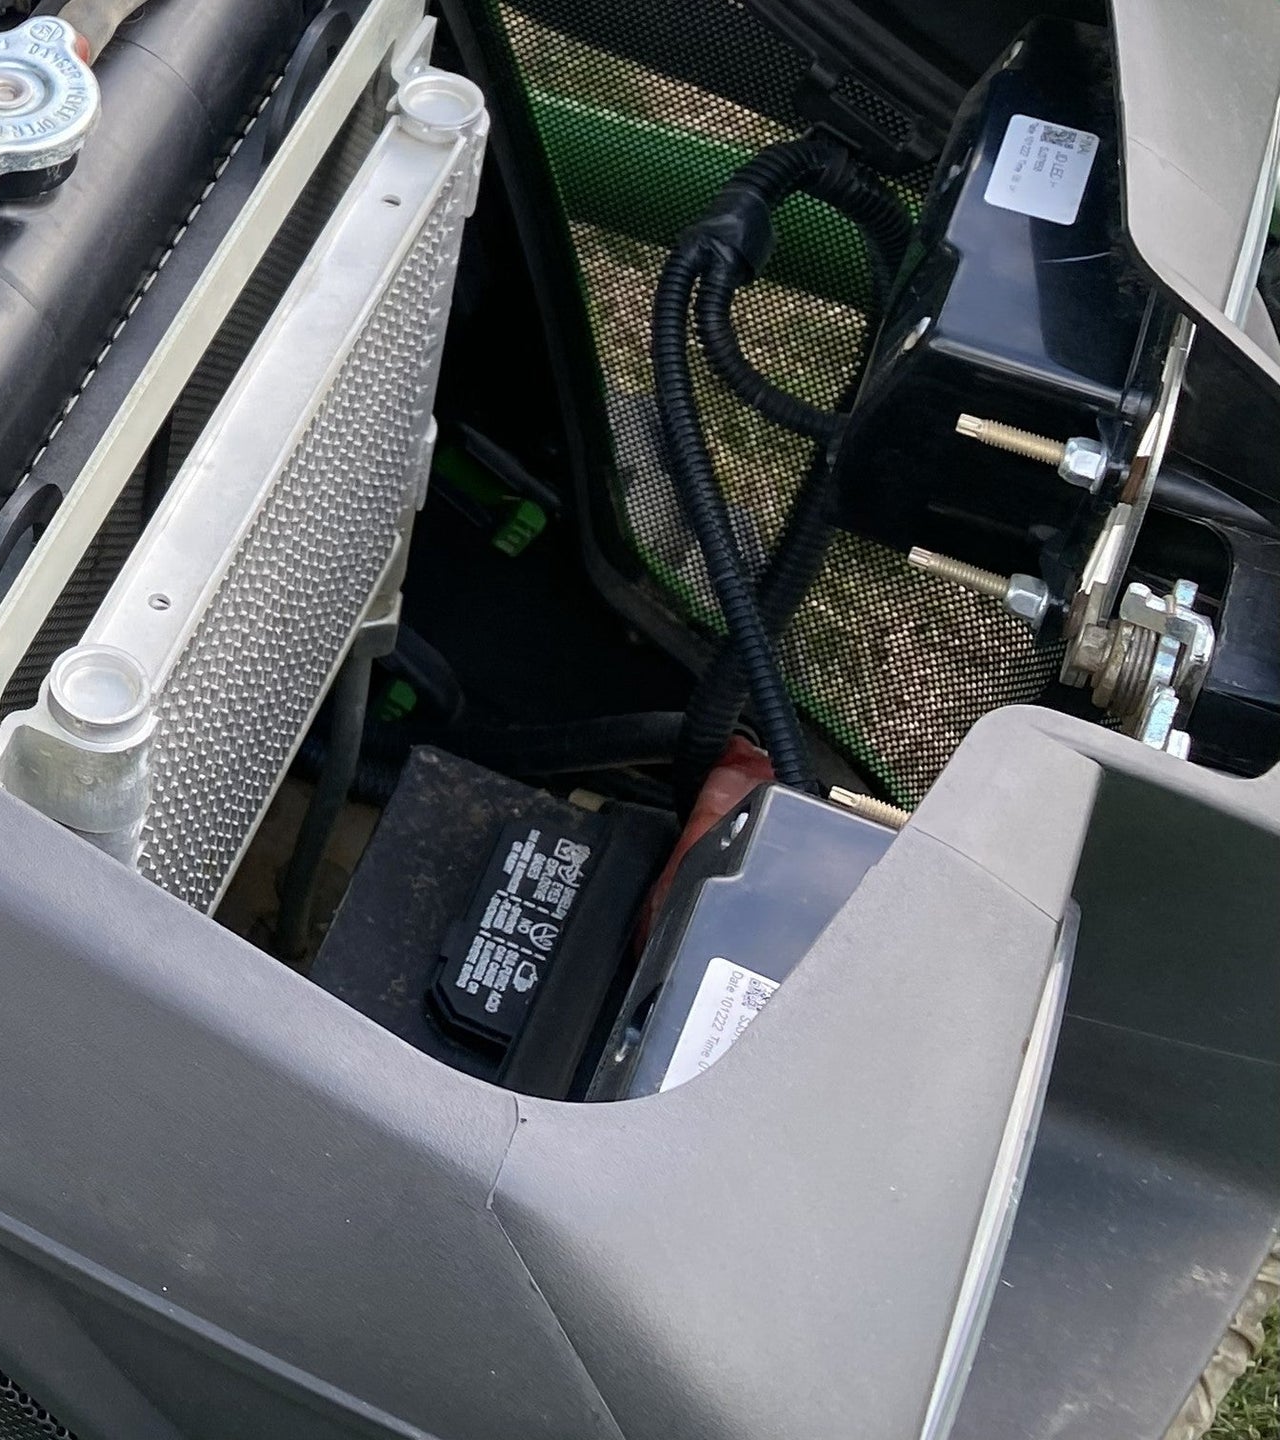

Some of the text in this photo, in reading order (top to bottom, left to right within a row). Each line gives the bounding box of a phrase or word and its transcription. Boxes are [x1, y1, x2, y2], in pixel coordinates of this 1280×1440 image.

[726, 970, 744, 993] Date
[711, 996, 735, 1032] 101222
[701, 1035, 721, 1058] Time
